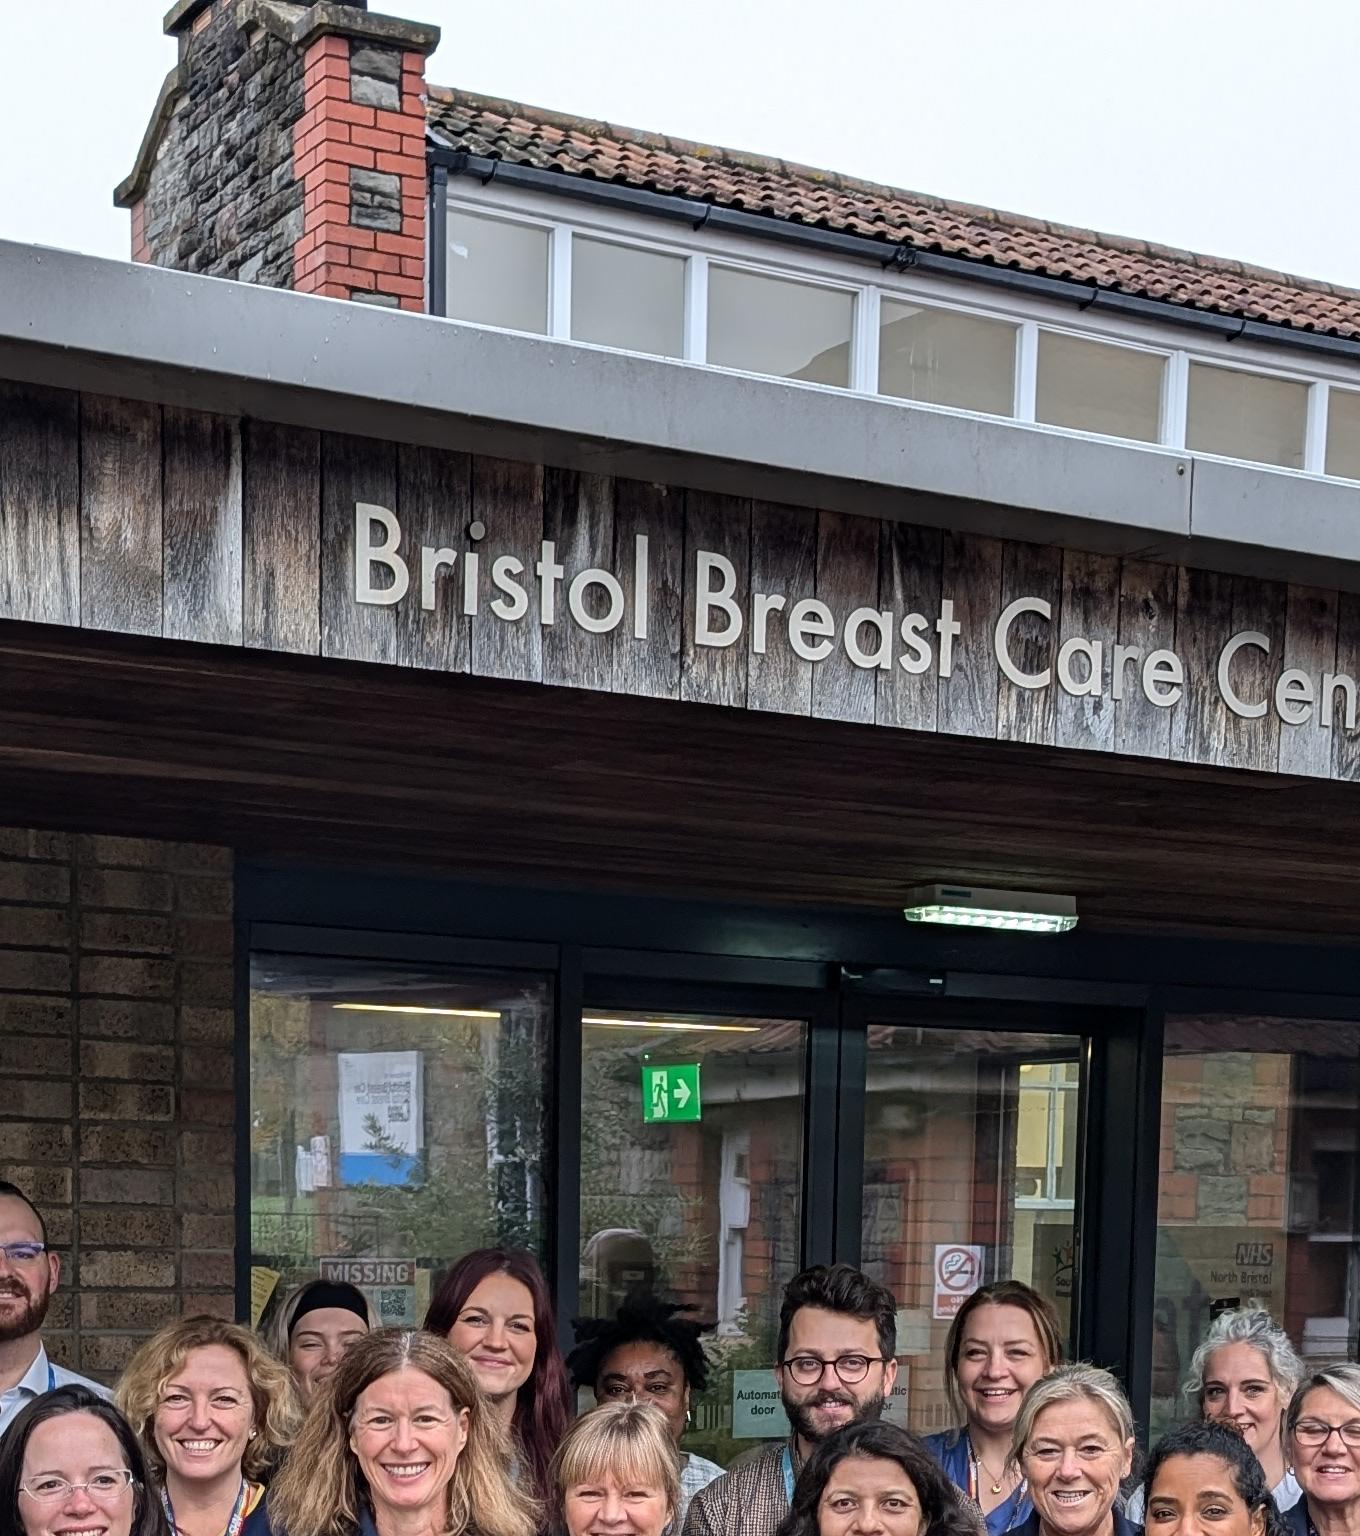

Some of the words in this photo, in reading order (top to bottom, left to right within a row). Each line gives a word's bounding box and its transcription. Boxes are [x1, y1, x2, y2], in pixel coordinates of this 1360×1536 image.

[355, 503, 648, 640] Bristol
[694, 549, 961, 679] Breast
[994, 595, 1185, 708] Care
[1237, 1243, 1273, 1266] NHS
[327, 1264, 409, 1283] MISSING
[1210, 1271, 1237, 1283] North
[1241, 1271, 1272, 1285] Bristol
[737, 1390, 781, 1400] Automat
[750, 1405, 775, 1415] door
